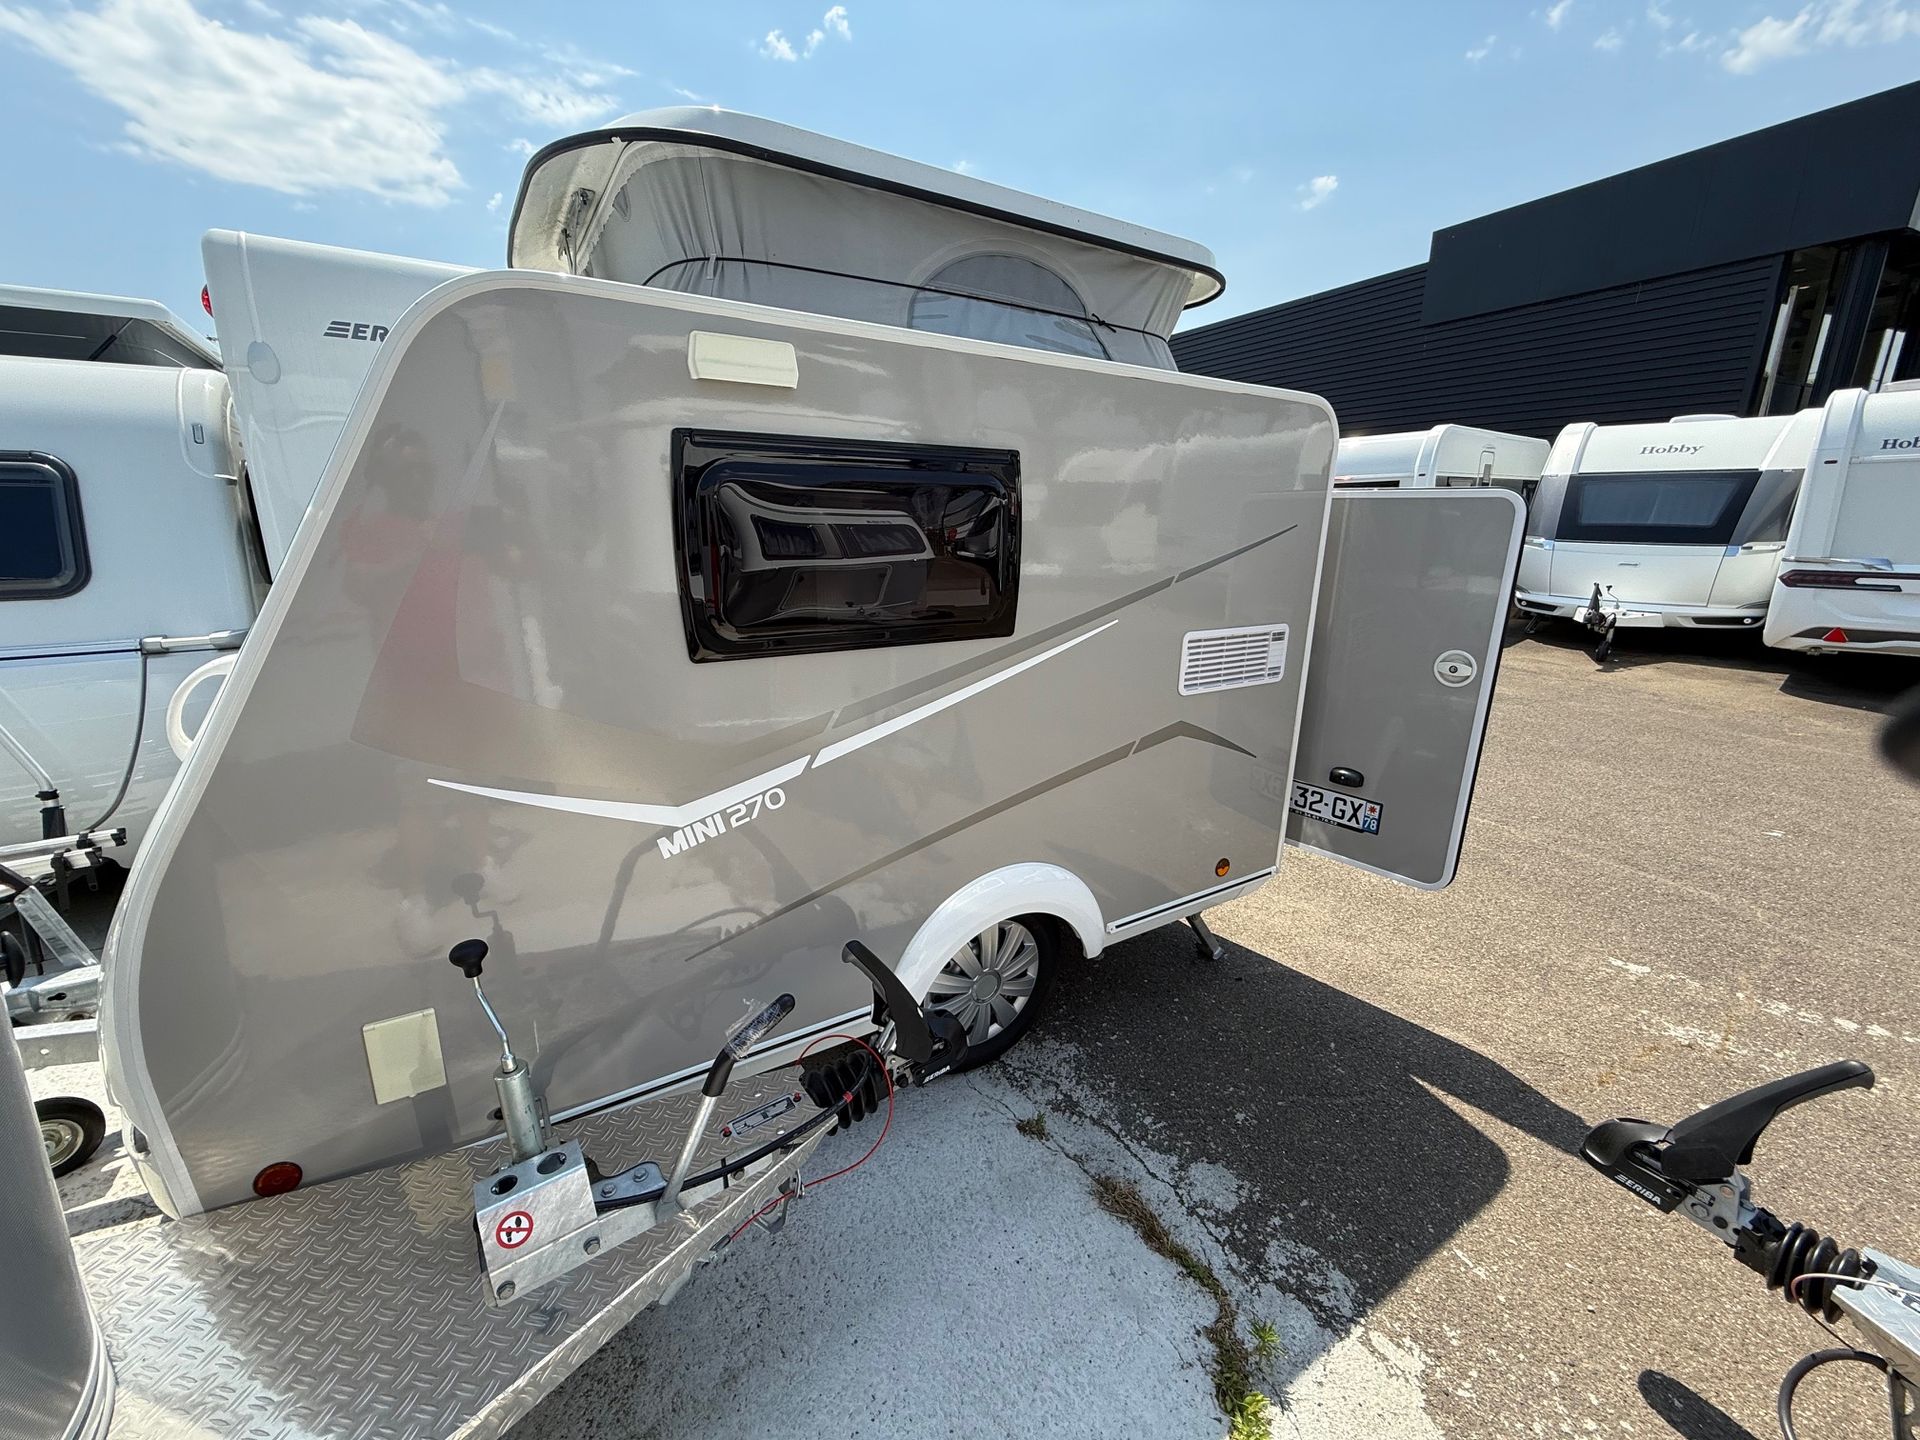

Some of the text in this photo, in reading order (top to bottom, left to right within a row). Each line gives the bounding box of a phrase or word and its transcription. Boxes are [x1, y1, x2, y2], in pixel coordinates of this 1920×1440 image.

[1639, 444, 1704, 455] Hobby
[1289, 785, 1364, 826] 32-GX
[656, 787, 786, 860] MINI 270
[1364, 817, 1378, 831] 78
[1626, 1179, 1661, 1205] ERIBA
